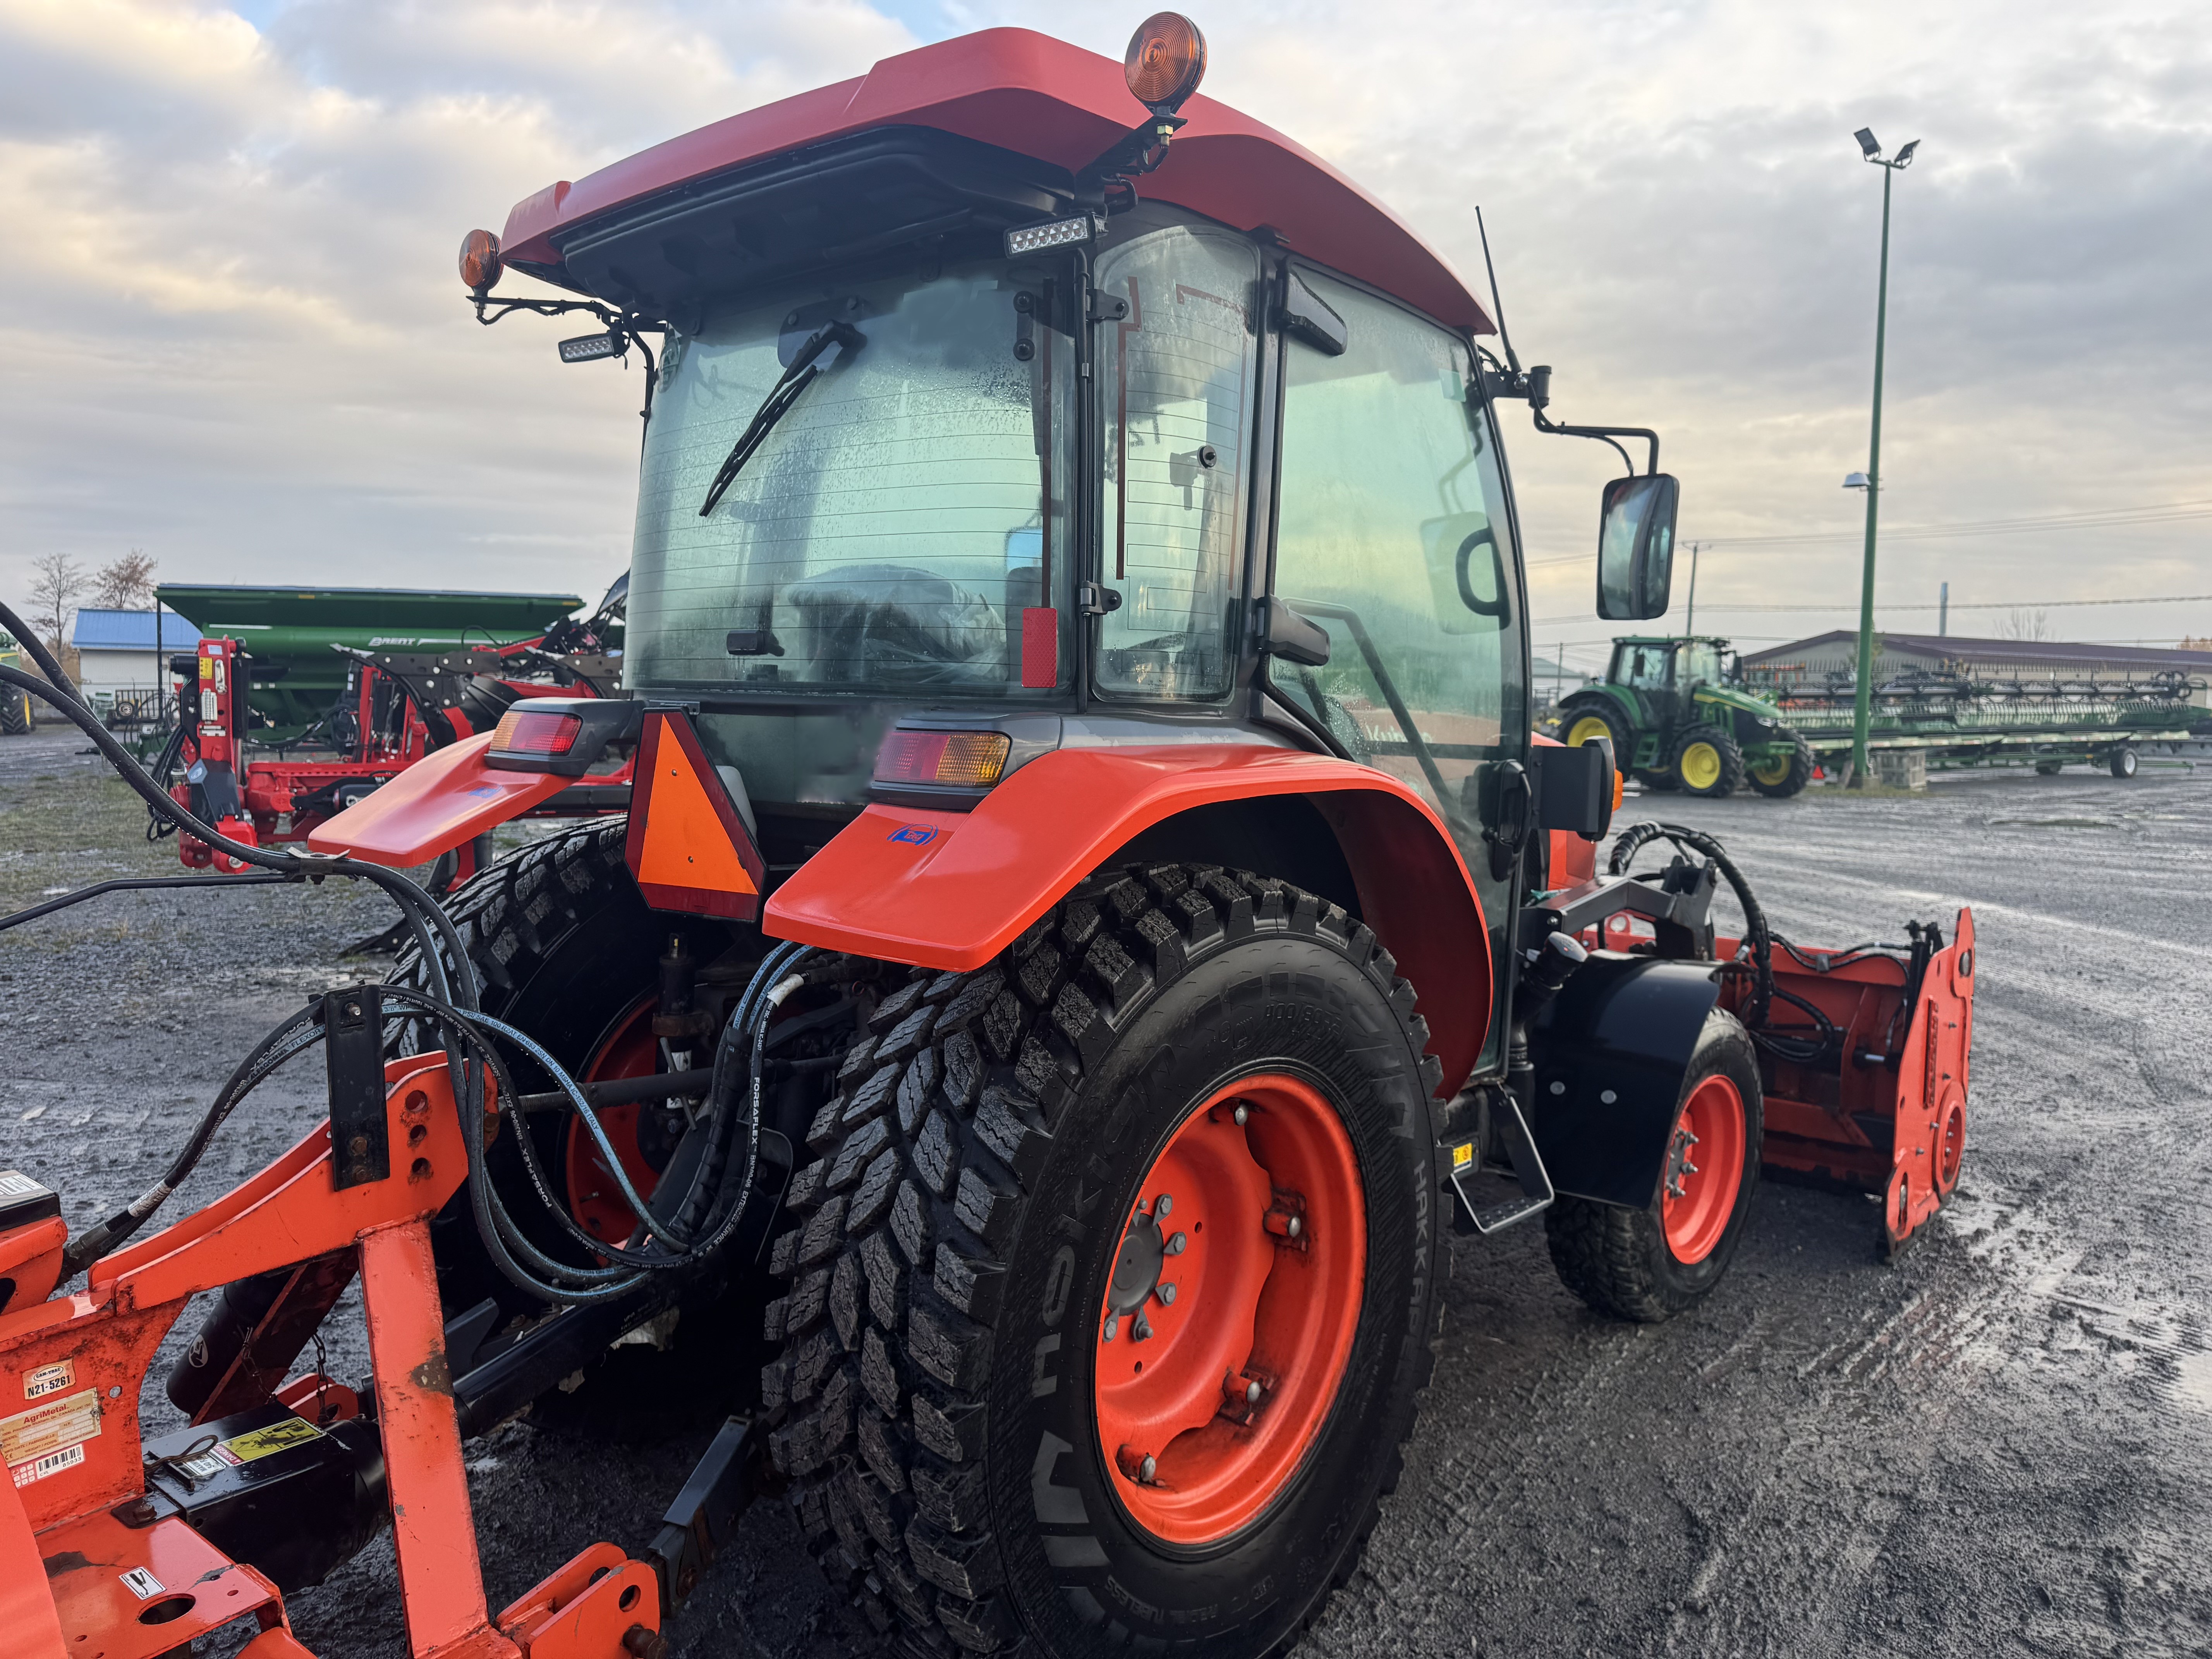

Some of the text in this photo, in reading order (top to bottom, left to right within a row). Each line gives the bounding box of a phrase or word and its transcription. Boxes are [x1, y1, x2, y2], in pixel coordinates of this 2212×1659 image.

[291, 1028, 321, 1048] FLEXOR
[476, 1015, 490, 1023] SAE
[491, 1020, 501, 1029] 100
[535, 1048, 547, 1060] 2SN
[545, 1056, 555, 1067] DN
[559, 1072, 574, 1089] MSHA
[586, 1113, 600, 1130] ITALY
[751, 1076, 760, 1145] FORSAFLEX
[36, 1367, 61, 1378] CAM-TRAC
[27, 1375, 71, 1397] N21-5261
[23, 1403, 67, 1424] AgriMetal
[215, 1444, 237, 1461] DANGER
[1104, 1573, 1165, 1625] TUBELESS
